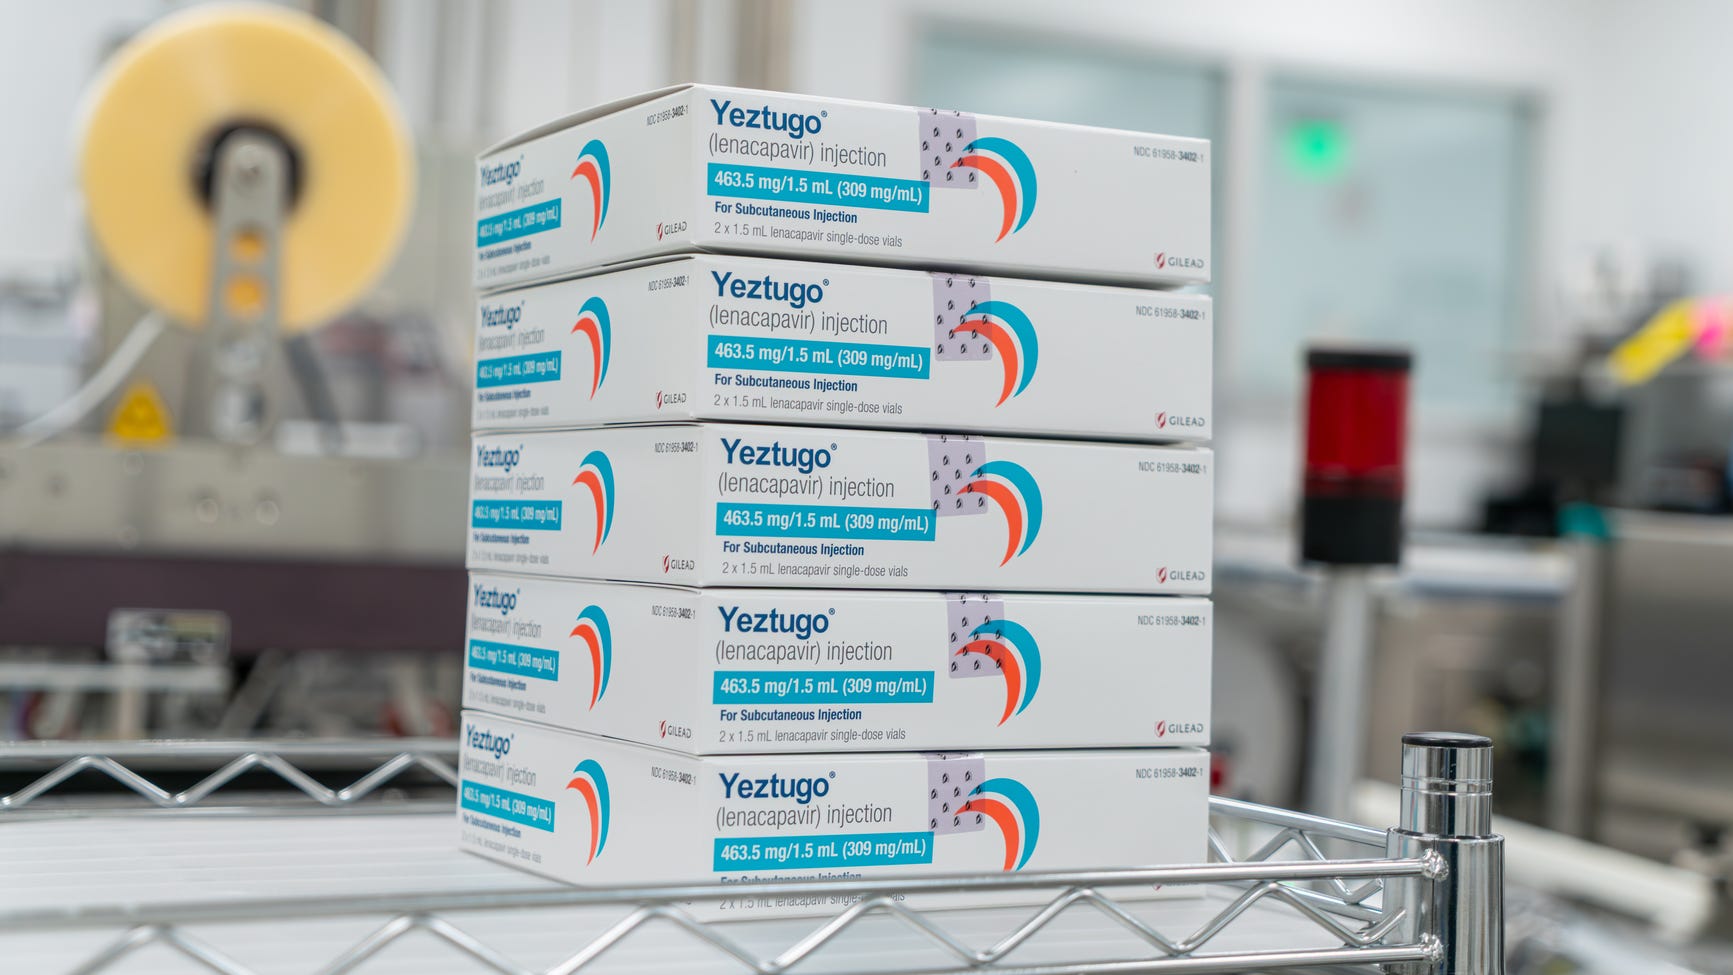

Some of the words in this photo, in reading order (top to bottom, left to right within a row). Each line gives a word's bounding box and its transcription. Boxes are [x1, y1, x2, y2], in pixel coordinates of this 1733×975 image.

[709, 132, 814, 164] (lenacapavir)
[821, 143, 886, 167] injection
[1134, 146, 1150, 157] NDC
[1152, 148, 1203, 162] 61958-3402-1
[481, 154, 522, 188] Yeztugo
[715, 170, 754, 188] 463.5
[759, 176, 808, 193] mg/1.5
[812, 180, 833, 195] mL
[838, 181, 867, 199] (309
[871, 186, 921, 206] mg/mL)
[716, 201, 732, 213] For
[736, 202, 810, 219] Subcutaneous
[813, 209, 857, 223] Injection
[664, 222, 687, 235] GILEAD
[715, 221, 721, 233] 2
[724, 225, 729, 234] x
[734, 224, 748, 236] 1.5
[752, 225, 768, 237] mL
[770, 226, 824, 242] lenacapavir
[827, 230, 879, 246] single-dose
[882, 235, 902, 247] vials
[1168, 257, 1204, 268] GILEAD
[481, 300, 523, 330] Yeztugo
[710, 304, 815, 334] (lenacapavir)
[822, 312, 887, 336] injection
[1136, 306, 1152, 316] NDC
[1155, 308, 1205, 320] 61958-3402-1
[715, 342, 754, 359] 463.5
[759, 346, 808, 363] mg/1.5
[813, 348, 833, 364] mL
[838, 349, 868, 367] (309
[872, 353, 922, 372] mg/mL)
[715, 374, 732, 385] For
[736, 374, 810, 389] Subcutaneous
[813, 379, 857, 392] Injection
[664, 393, 686, 404] GILEAD
[715, 393, 721, 406] 2
[724, 397, 729, 406] x
[734, 395, 748, 407] 1.5
[752, 396, 767, 408] mL
[770, 397, 824, 412] lenacapavir
[827, 400, 879, 414] single-dose
[882, 402, 902, 414] vials
[1169, 416, 1204, 427] GILEAD
[477, 444, 522, 473] Yeztugo
[1139, 462, 1154, 472] NDC
[1157, 463, 1206, 474] 61958-3402-1
[719, 471, 822, 499] (lenacapavir)
[830, 476, 894, 500] injection
[724, 510, 763, 526] 463.5
[768, 512, 816, 529] mg/1.5
[820, 513, 840, 528] mL
[845, 514, 874, 532] (309
[878, 516, 928, 534] mg/mL)
[724, 541, 740, 552] For
[744, 541, 818, 554] Subcutaneous
[821, 544, 864, 557] Injection
[671, 560, 694, 570] GILEAD
[723, 561, 729, 573] 2
[732, 564, 737, 574] x
[742, 562, 756, 574] 1.5
[760, 563, 775, 575] mL
[778, 563, 831, 577] lenacapavir
[834, 564, 886, 578] single-dose
[888, 565, 907, 576] vials
[1170, 571, 1205, 580] GILEAD
[474, 584, 519, 616] Yeztugo
[1138, 616, 1154, 625] NDC
[1156, 616, 1205, 625] 61958-3402-1
[716, 640, 820, 664] (lenacapavir)
[828, 641, 892, 665] injection
[721, 678, 760, 693] 463.5
[765, 678, 813, 696] mg/1.5
[818, 678, 838, 693] mL
[843, 678, 872, 696] (309
[876, 678, 926, 696] mg/mL)
[721, 710, 737, 721] For
[741, 709, 815, 721] Subcutaneous
[818, 709, 861, 722] Injection
[668, 725, 691, 738] GILEAD
[720, 730, 726, 742] 2
[729, 733, 734, 742] x
[739, 730, 753, 742] 1.5
[757, 730, 772, 742] mL
[775, 729, 828, 743] lenacapavir
[831, 729, 883, 743] single-dose
[886, 728, 905, 739] vials
[1169, 724, 1203, 733] GILEAD
[466, 724, 513, 760] Yeztugo
[1136, 769, 1152, 778] NDC
[1154, 768, 1202, 778] 61958-3402-1
[717, 805, 820, 831] (lenacapavir)
[828, 803, 892, 828] injection
[721, 845, 760, 860] 463.5
[765, 843, 813, 862] mg/1.5
[818, 842, 838, 857] mL
[843, 840, 872, 859] (309
[876, 839, 925, 858] mg/mL)
